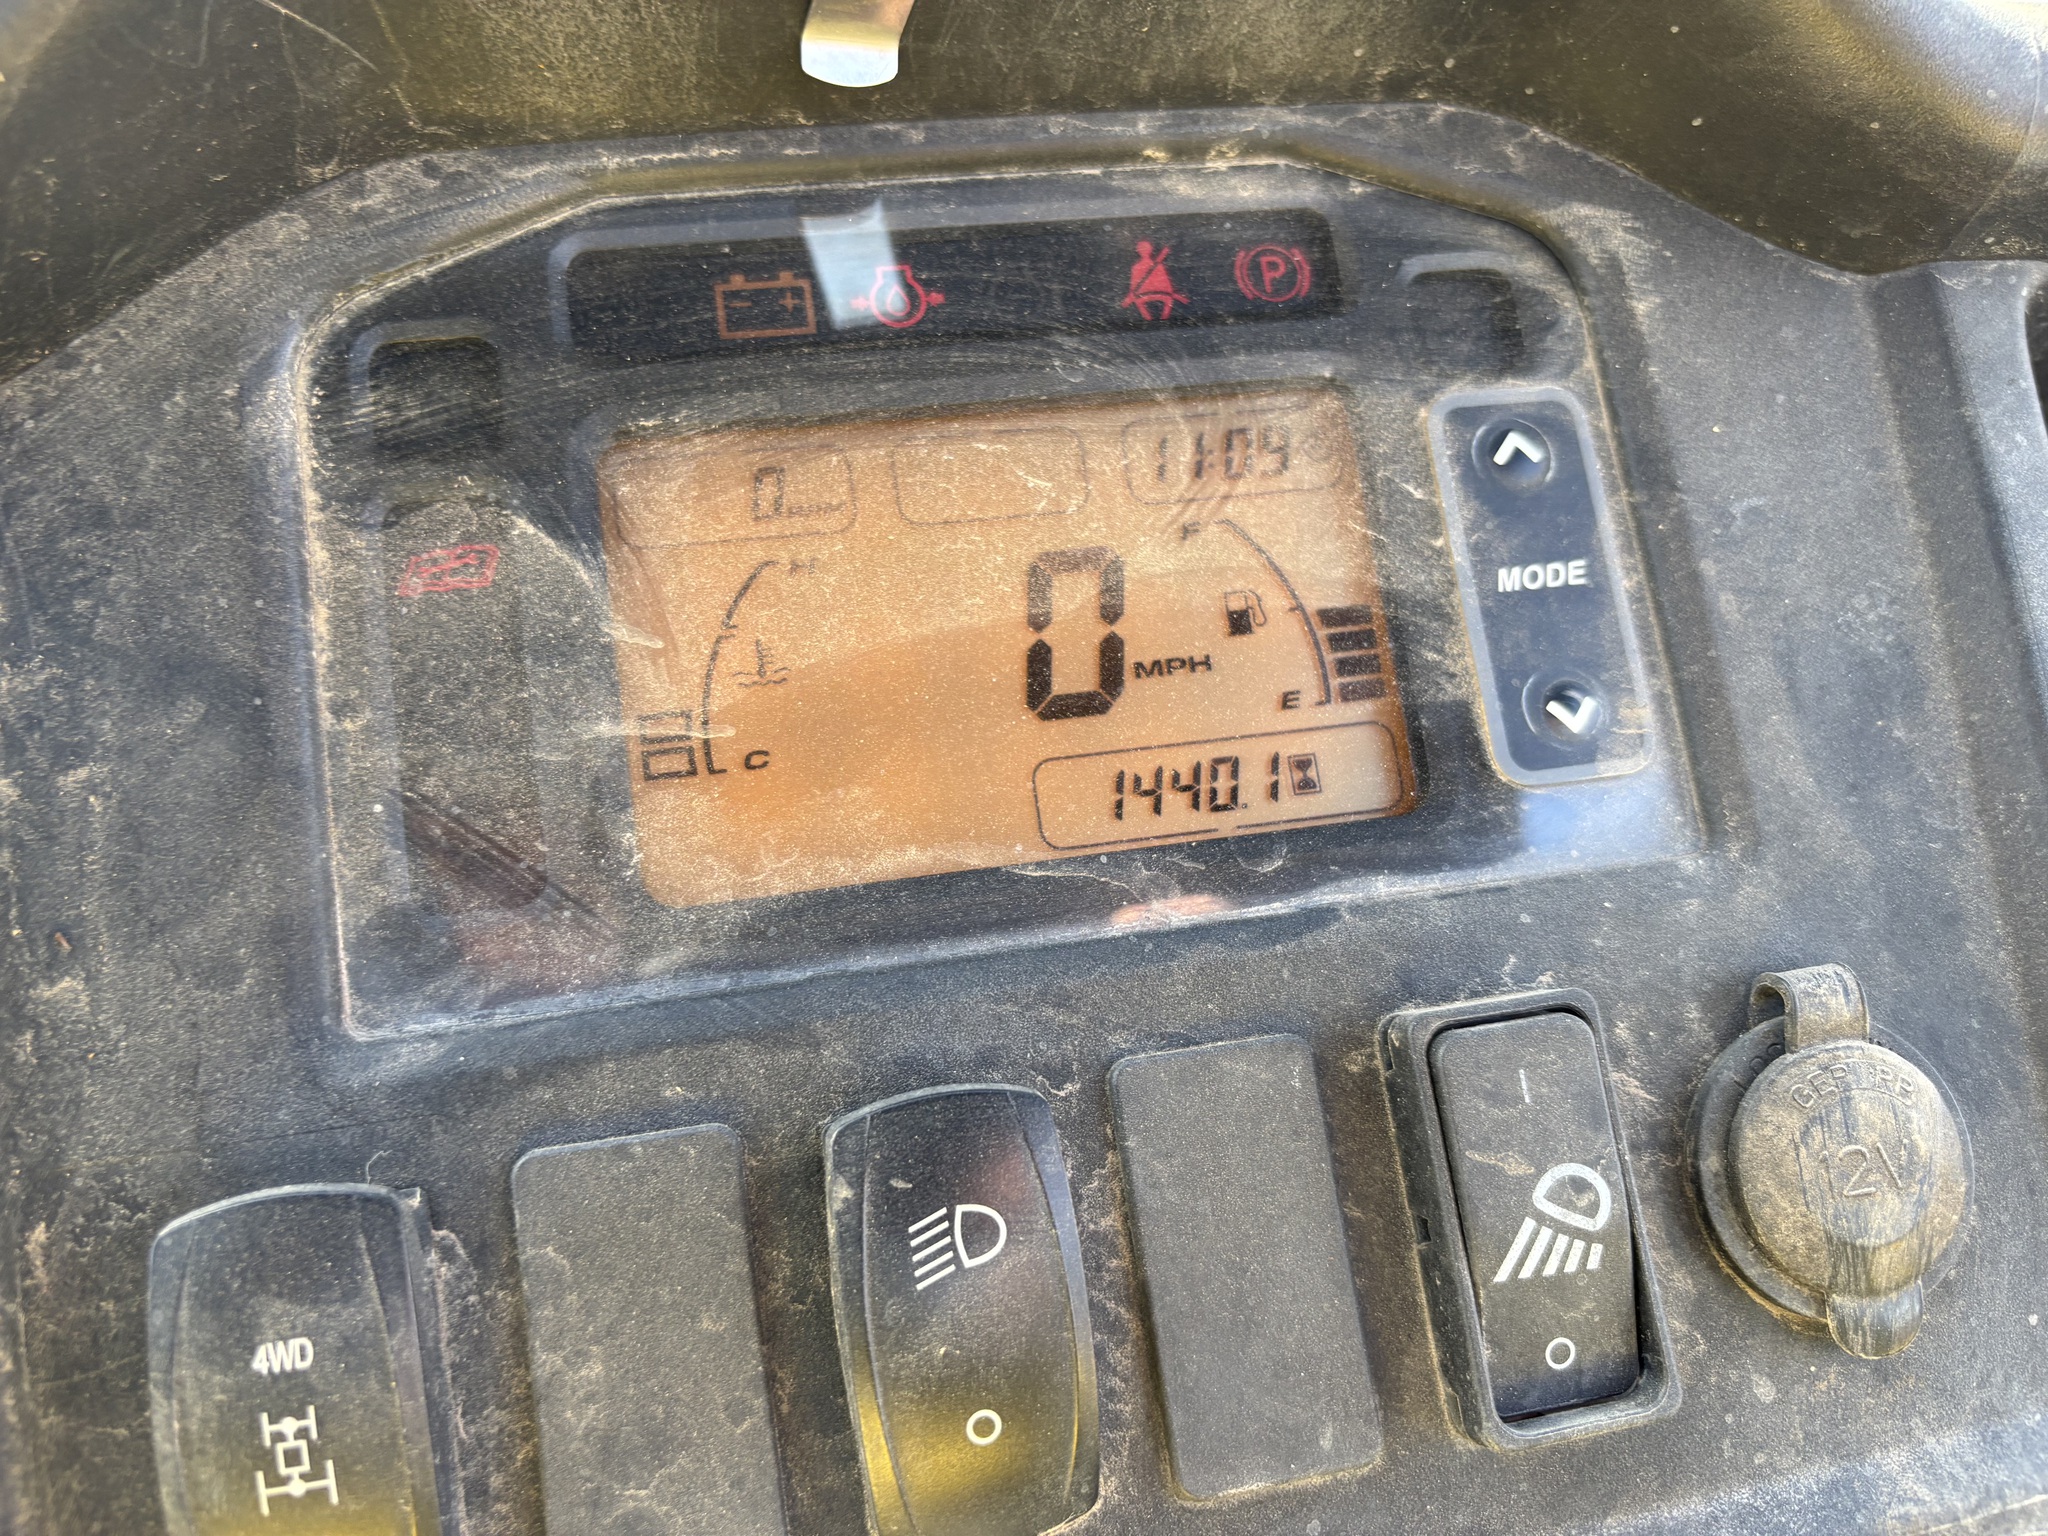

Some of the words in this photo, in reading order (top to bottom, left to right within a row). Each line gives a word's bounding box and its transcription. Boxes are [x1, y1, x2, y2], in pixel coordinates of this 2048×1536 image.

[1157, 424, 1290, 482] 11:09
[752, 466, 785, 521] 0
[1181, 521, 1201, 541] F
[1497, 558, 1588, 593] MODE
[1026, 546, 1126, 722] 0
[1133, 653, 1213, 680] MPH
[1281, 690, 1301, 711] E
[744, 749, 771, 771] C
[1113, 750, 1281, 821] 1440.1
[251, 1336, 315, 1376] 4WD
